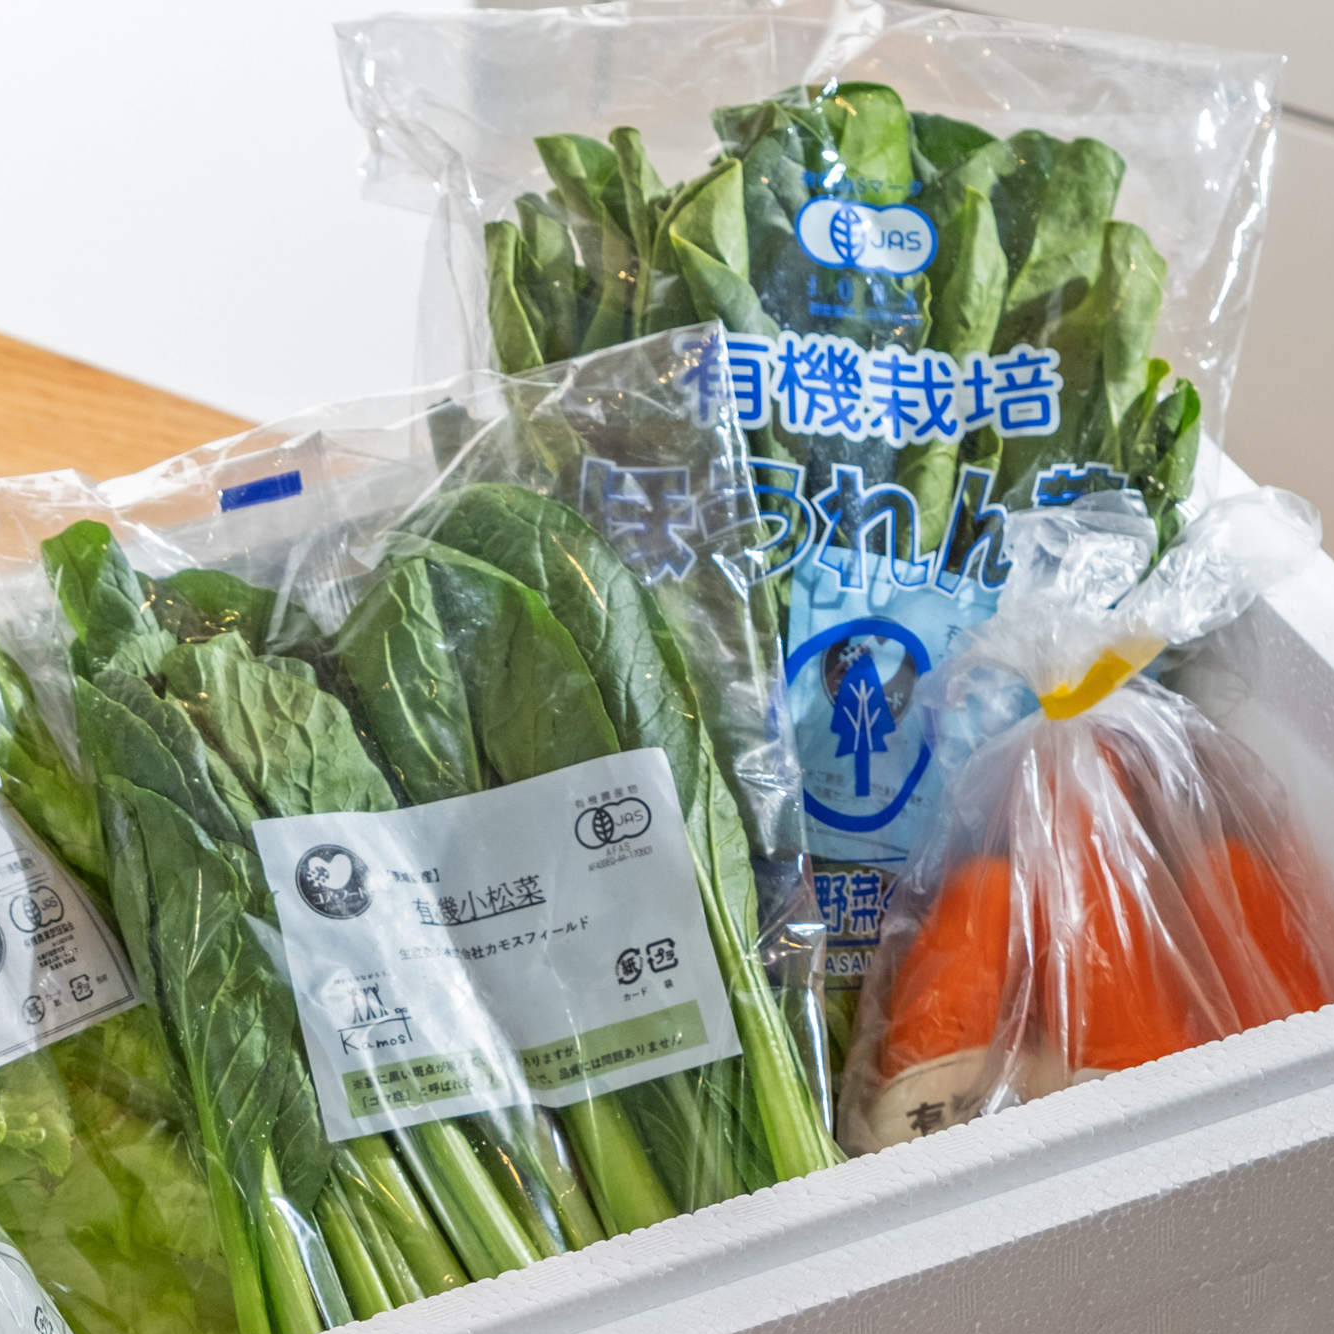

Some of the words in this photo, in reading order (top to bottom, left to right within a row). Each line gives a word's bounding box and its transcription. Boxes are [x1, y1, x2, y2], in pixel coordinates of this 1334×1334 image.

[870, 229, 922, 252] JAS
[680, 331, 1057, 439] 有機栽培
[614, 808, 645, 828] JAS
[621, 958, 640, 977] 紙
